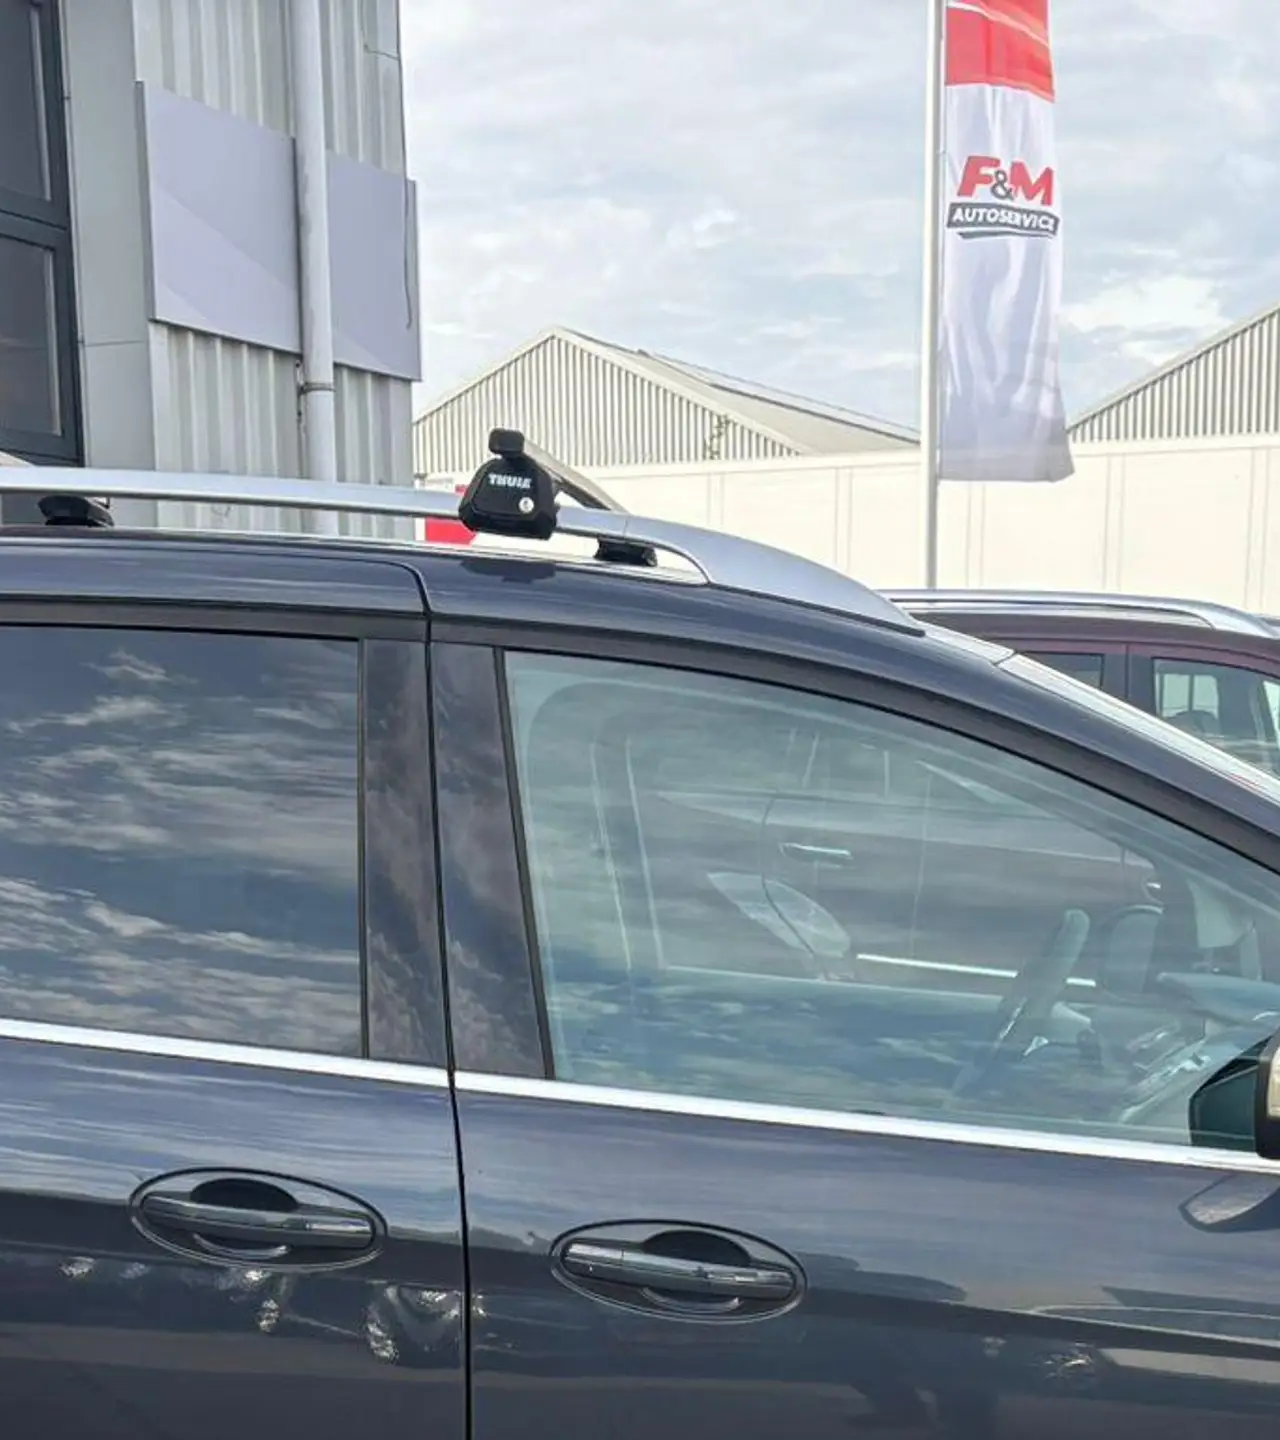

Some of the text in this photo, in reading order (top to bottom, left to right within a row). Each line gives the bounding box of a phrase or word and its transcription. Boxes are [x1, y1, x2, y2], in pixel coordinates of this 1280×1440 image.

[957, 155, 1054, 206] F&M
[952, 207, 1055, 230] AUTOSERVICE
[489, 472, 532, 488] THULE
